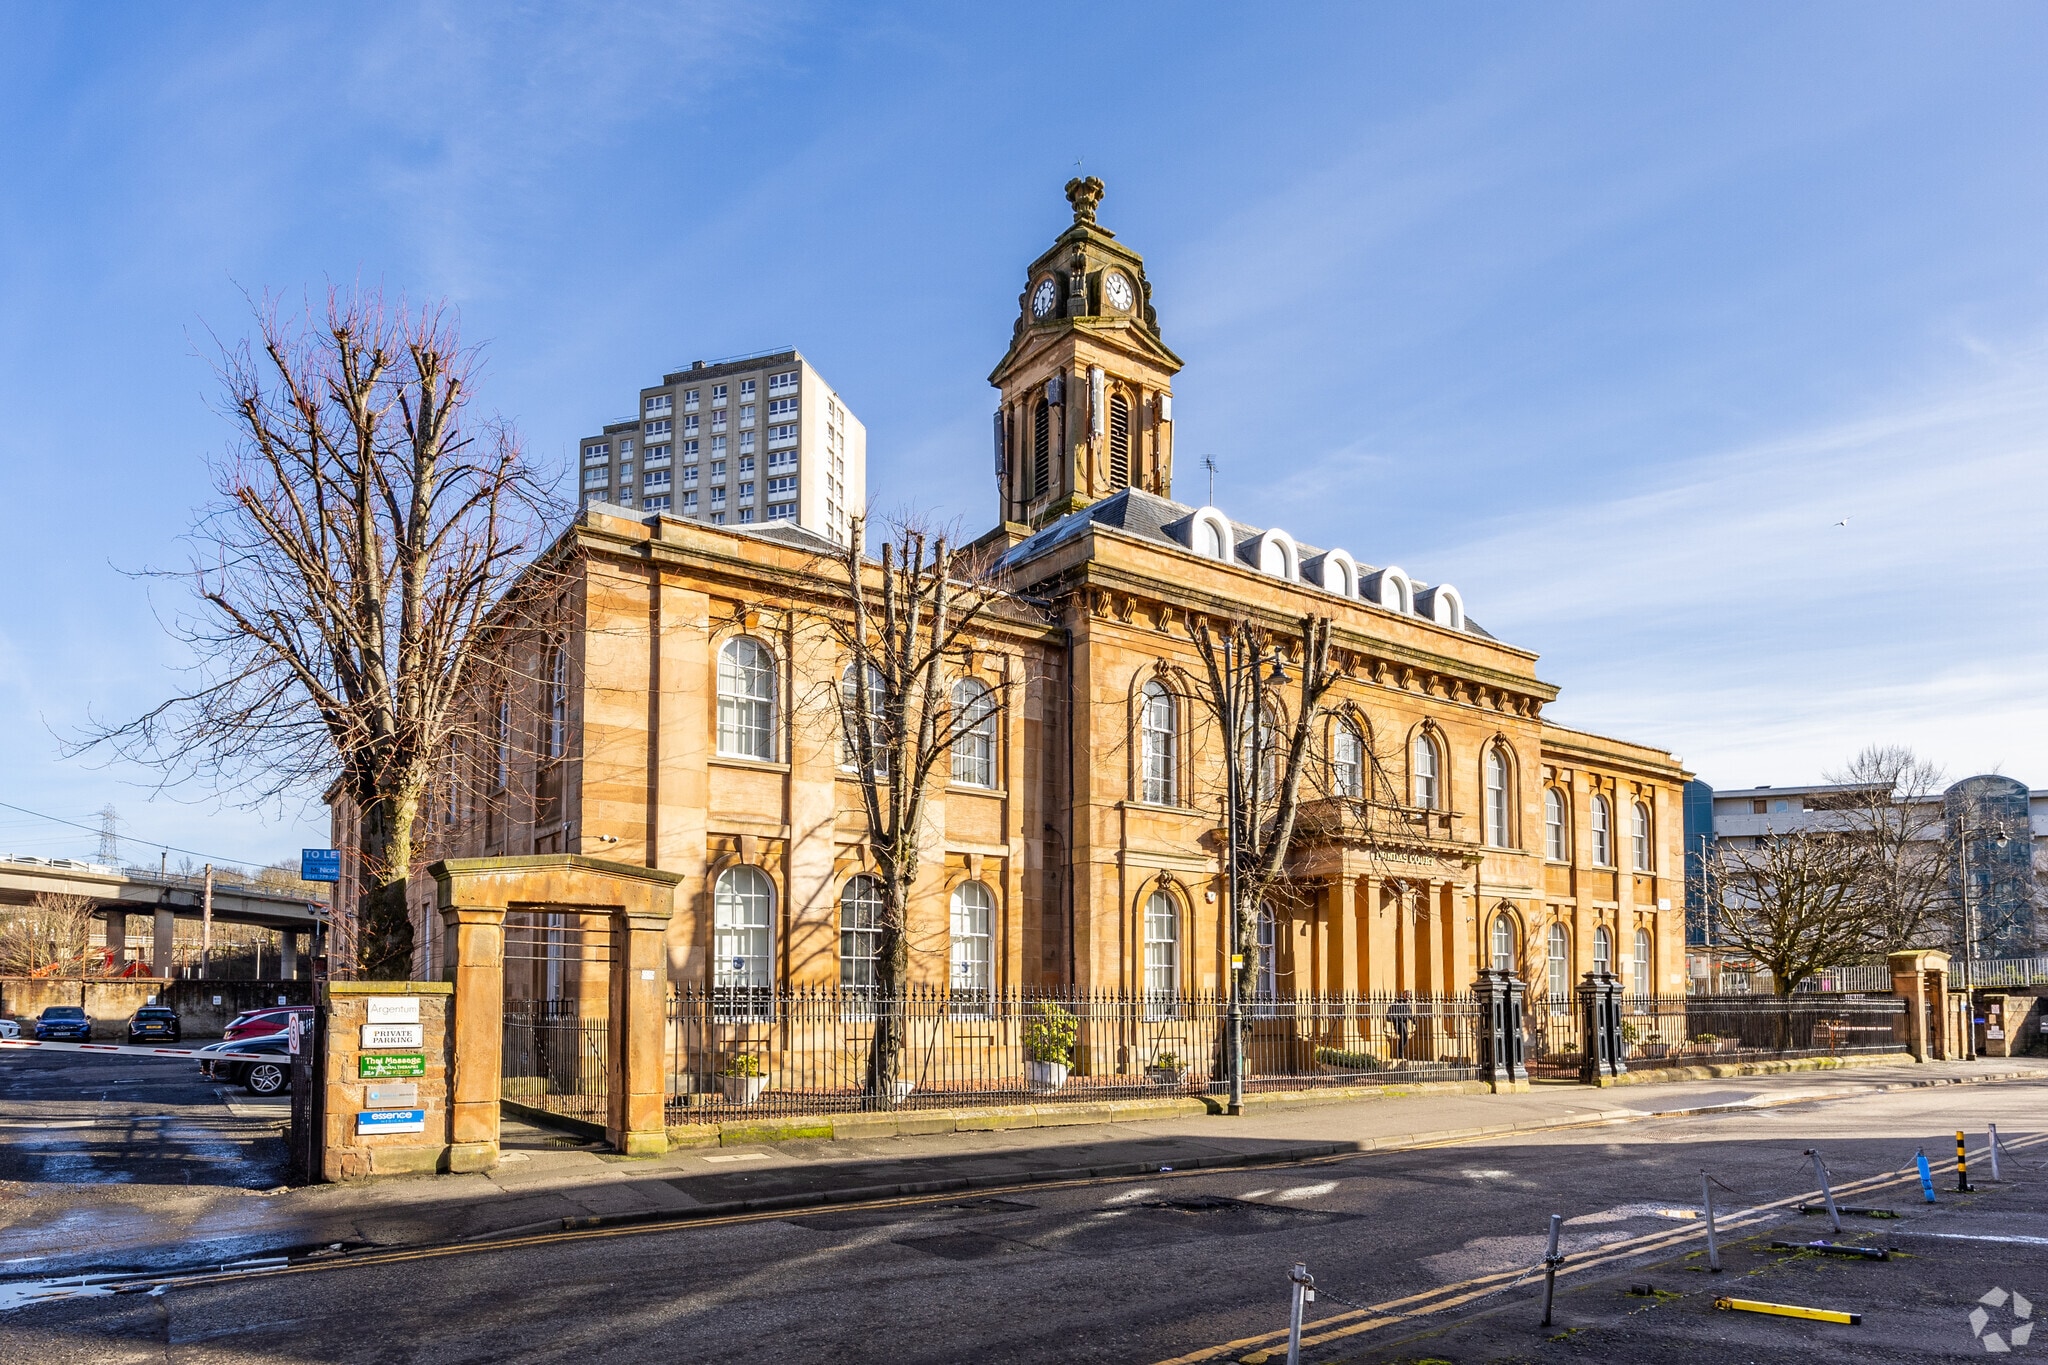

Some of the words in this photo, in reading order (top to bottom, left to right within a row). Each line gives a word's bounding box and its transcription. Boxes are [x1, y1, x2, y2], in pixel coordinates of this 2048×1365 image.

[304, 850, 320, 859] TO
[1409, 854, 1435, 866] COURT
[371, 1003, 417, 1016] Argentum
[364, 1057, 383, 1065] Thai
[385, 1056, 422, 1065] Massage
[371, 1111, 413, 1120] essence
